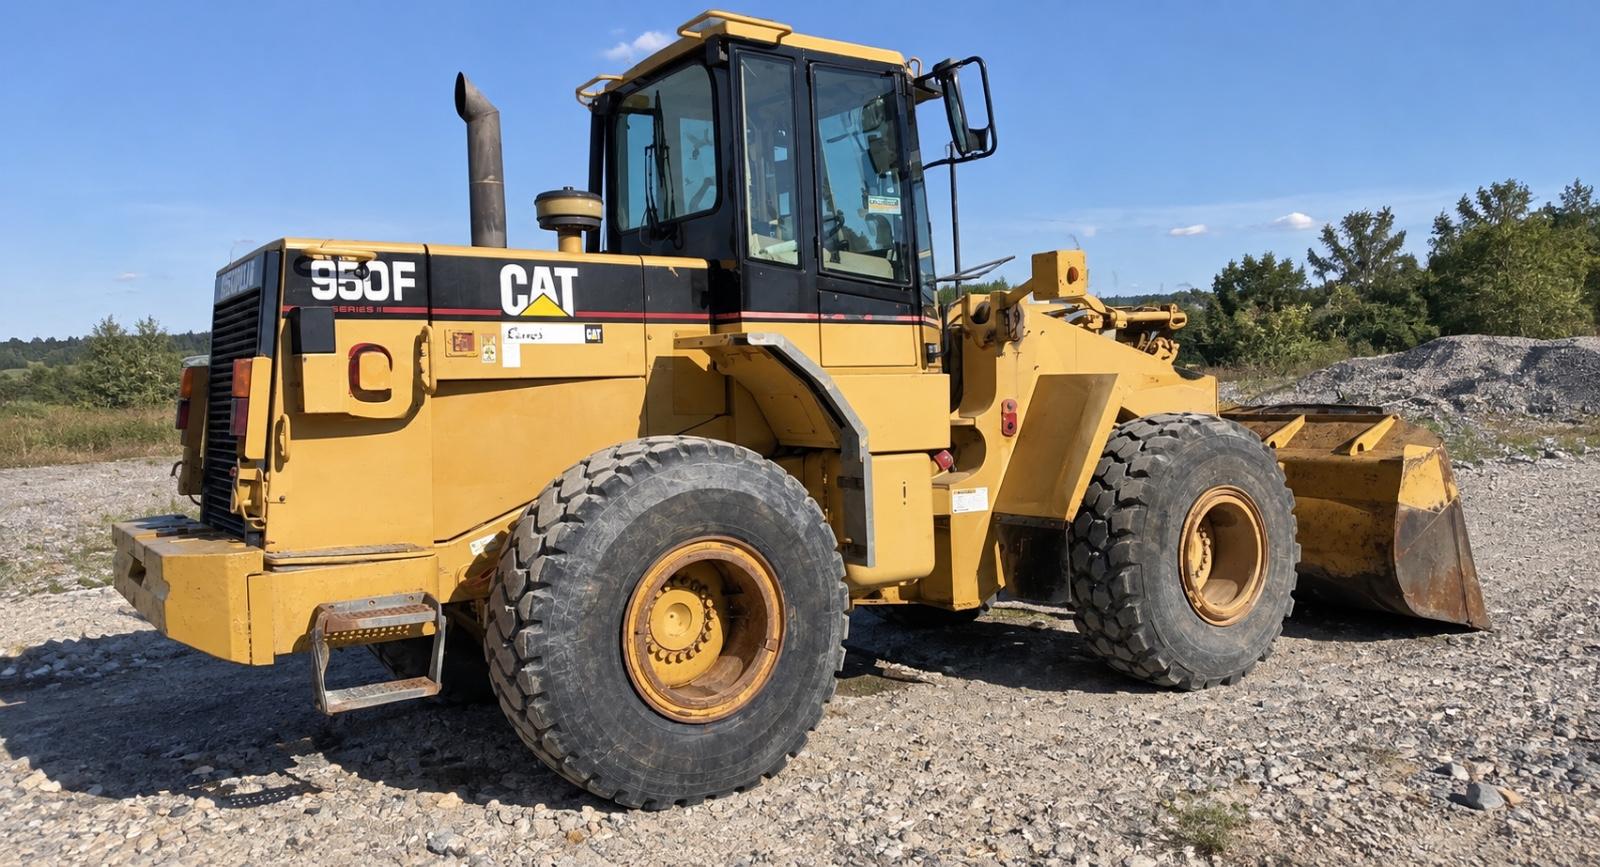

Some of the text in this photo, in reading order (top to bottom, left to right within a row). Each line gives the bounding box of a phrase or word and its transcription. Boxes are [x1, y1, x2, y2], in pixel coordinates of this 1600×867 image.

[310, 259, 416, 302] 950F
[500, 263, 578, 318] CAT
[332, 305, 375, 313] SERIES
[586, 328, 602, 340] CAT
